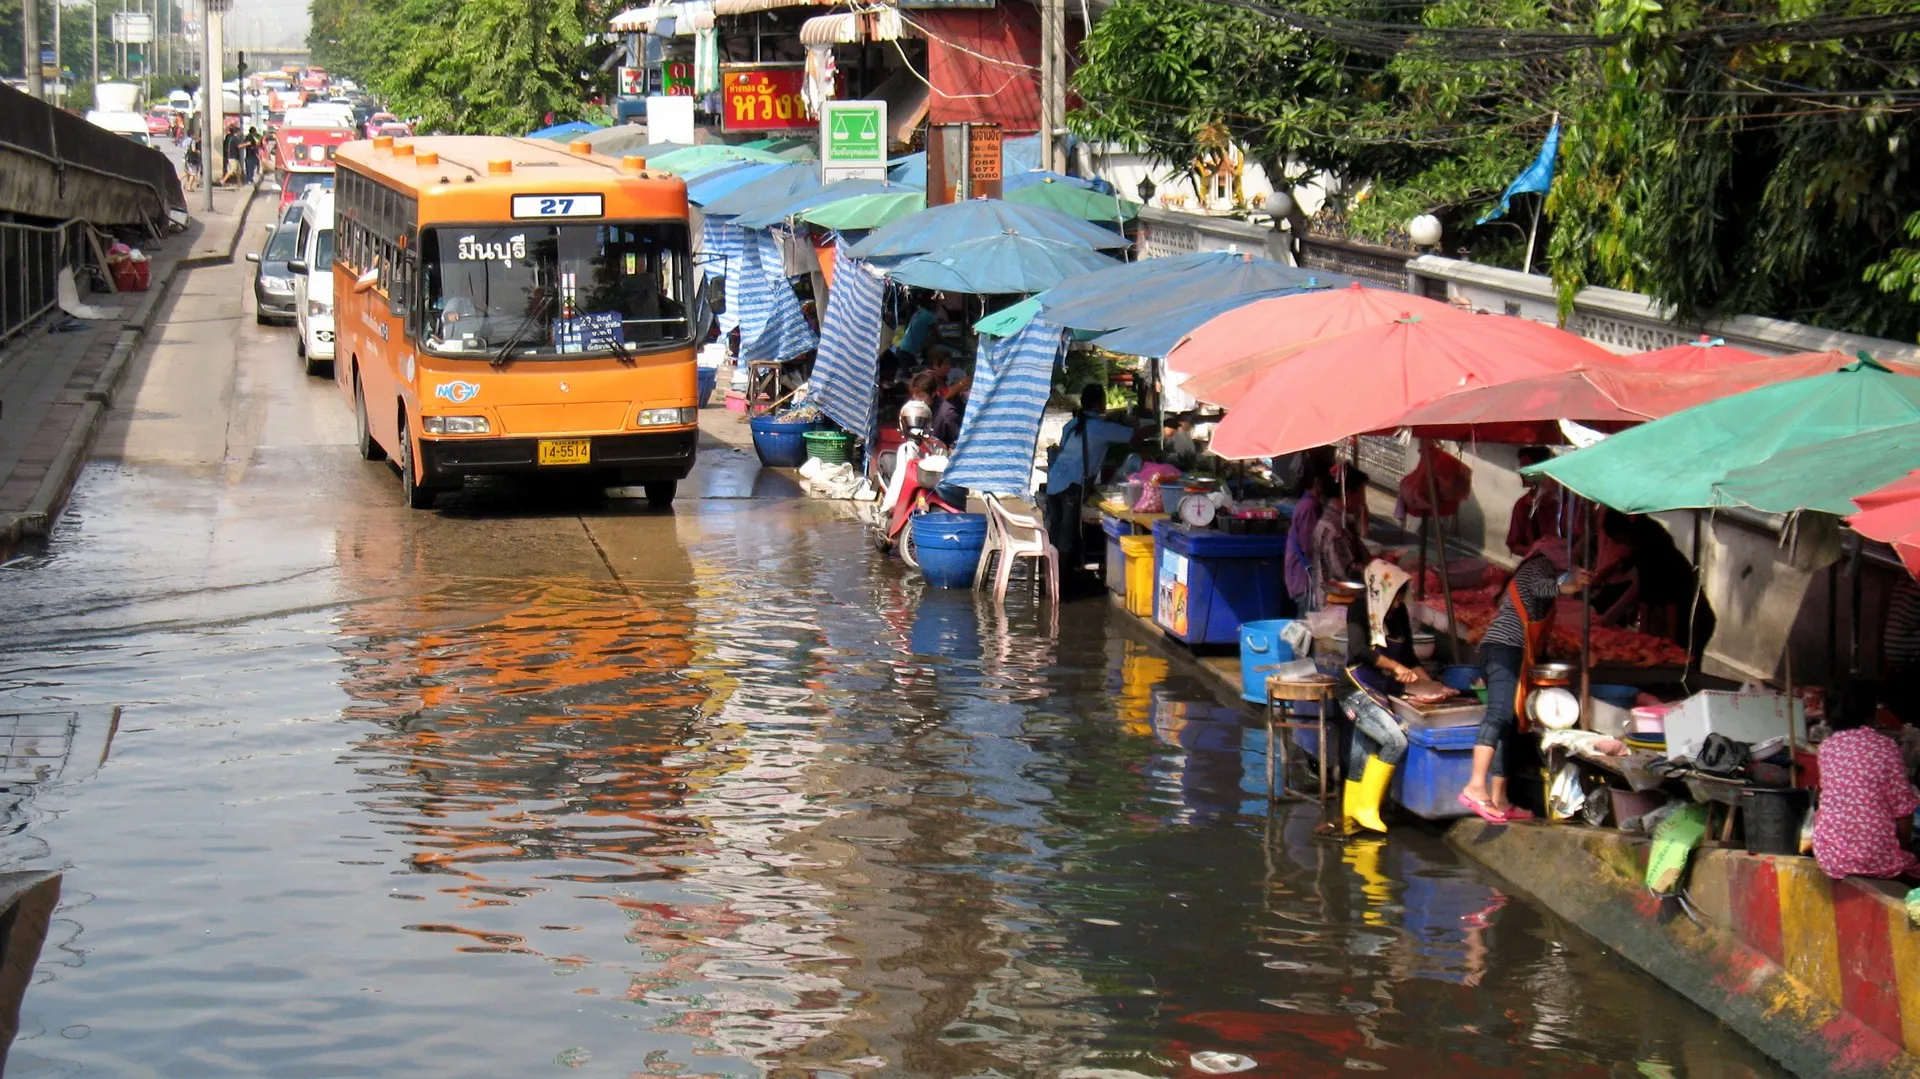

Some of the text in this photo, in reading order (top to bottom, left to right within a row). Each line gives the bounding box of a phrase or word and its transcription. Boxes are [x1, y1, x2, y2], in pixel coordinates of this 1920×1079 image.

[540, 199, 574, 215] 27
[458, 234, 526, 269] มีนบุรี
[436, 381, 480, 403] NGV
[544, 445, 587, 458] 14-5514
